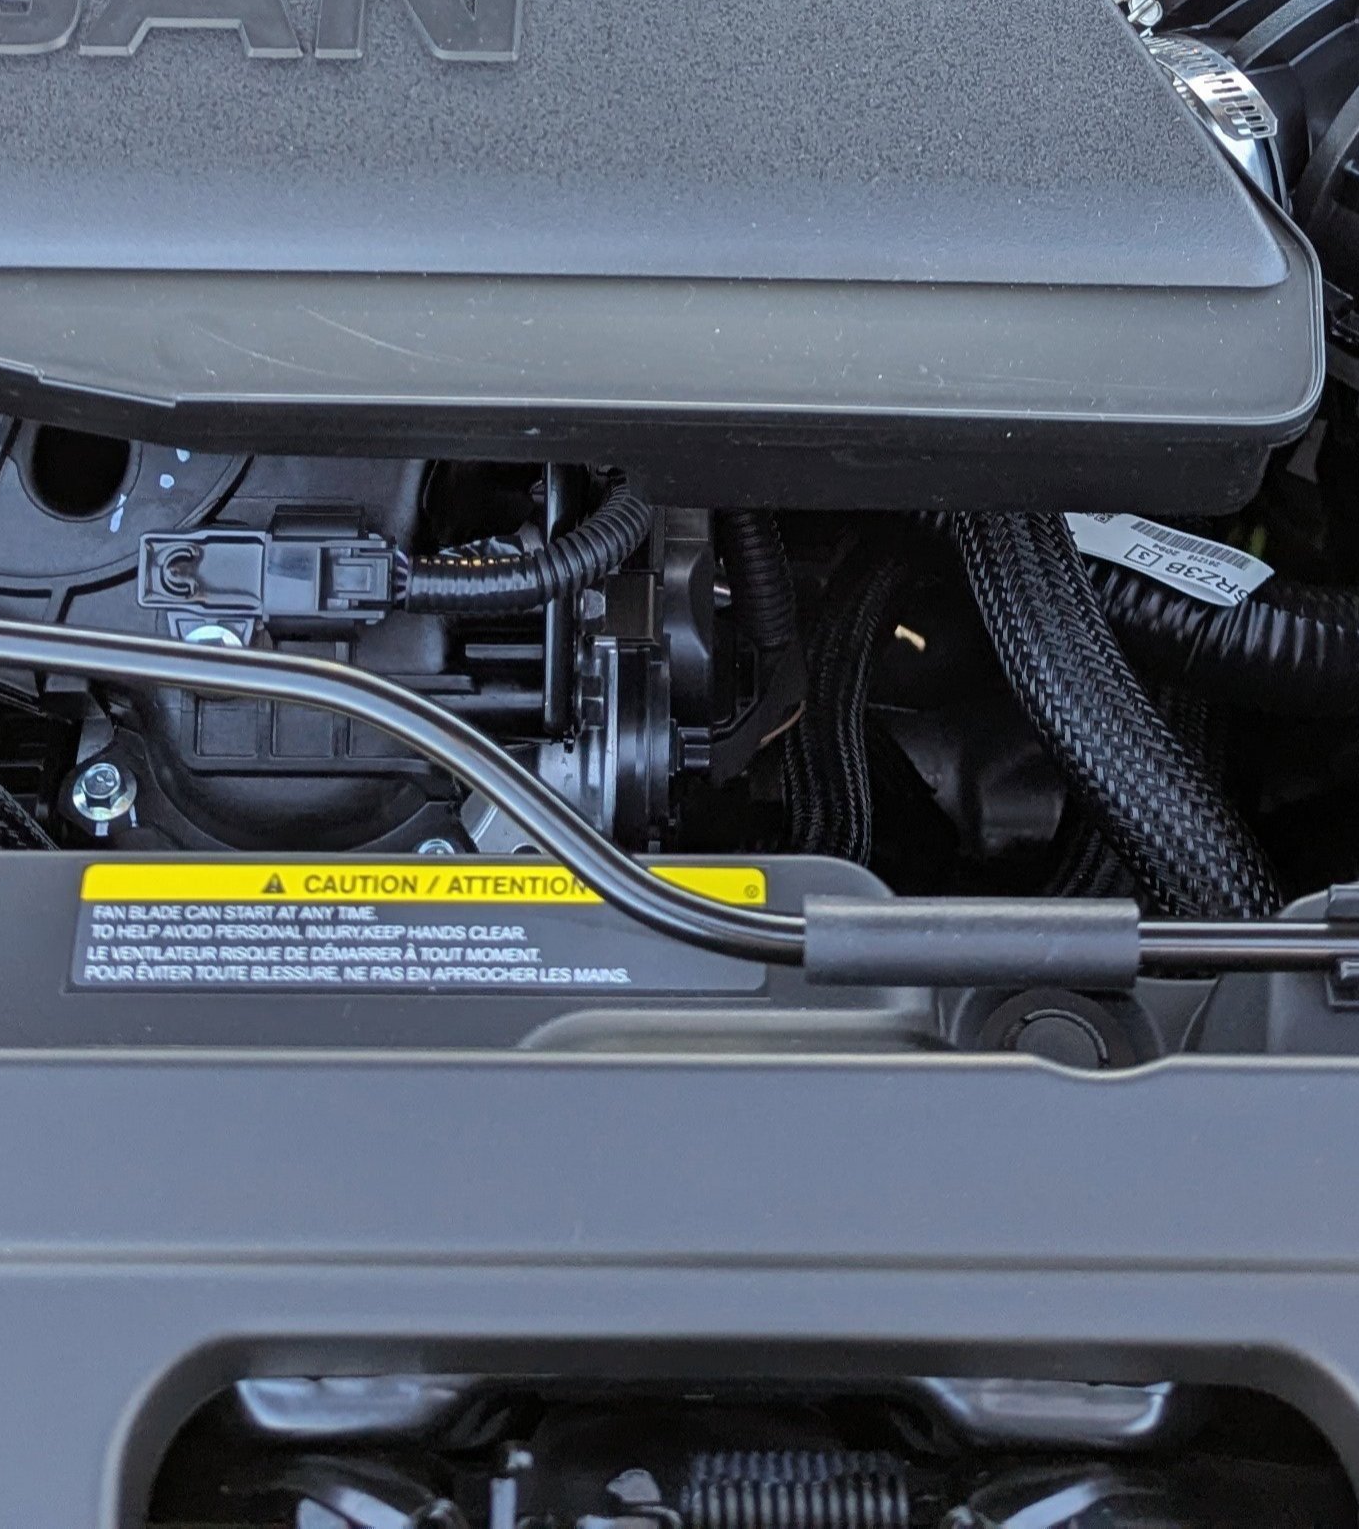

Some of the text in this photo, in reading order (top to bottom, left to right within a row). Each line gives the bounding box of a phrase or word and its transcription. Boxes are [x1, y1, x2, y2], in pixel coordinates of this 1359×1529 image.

[304, 875, 417, 894] CAUTION
[447, 875, 586, 894] ATTENTION
[92, 905, 378, 920] FAN BLADE CAN START AT ANY TIME.
[91, 924, 115, 940] TO
[116, 924, 161, 940] HELP
[161, 924, 213, 940] AVOID
[215, 924, 303, 940] PERSONAL
[407, 924, 466, 940] HANDS
[468, 925, 528, 941] CLEAR.
[86, 946, 109, 961] LE
[111, 946, 218, 961] VENTILATEUR
[219, 946, 282, 961] RISQUE
[284, 946, 309, 961] DE
[310, 942, 402, 962] DÉMARRER
[419, 946, 463, 961] TOUT
[465, 947, 542, 962] MOMENT.
[84, 965, 135, 981] POUR
[136, 962, 193, 981] ÉVITER
[195, 965, 248, 981] TOUTE
[343, 966, 368, 982] NE
[370, 966, 405, 982] PAS
[406, 966, 430, 982] EN
[433, 966, 540, 982] APPROCHER
[541, 967, 572, 983] LES
